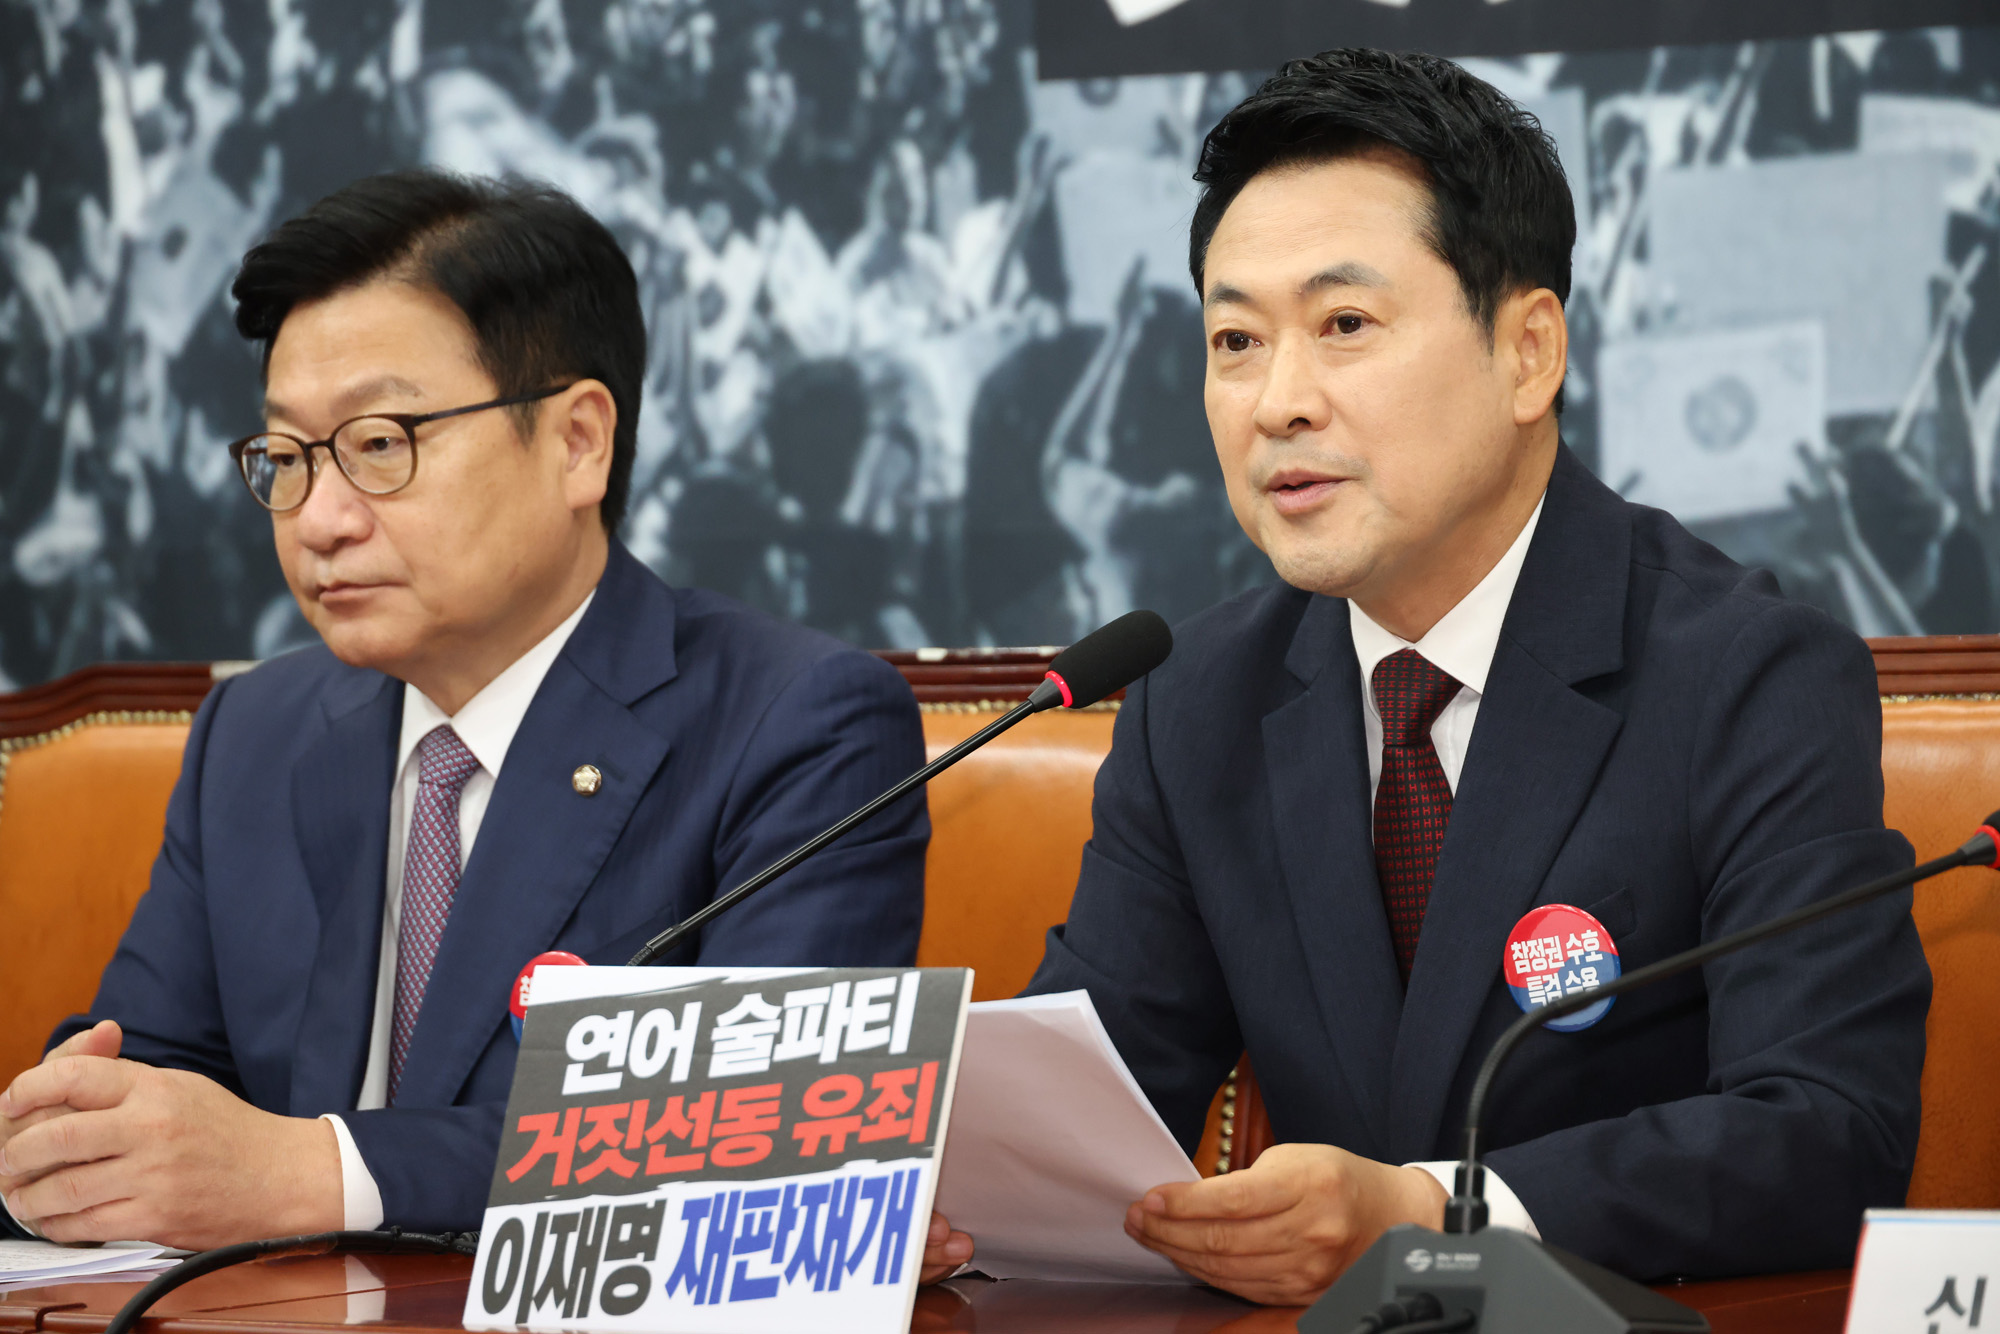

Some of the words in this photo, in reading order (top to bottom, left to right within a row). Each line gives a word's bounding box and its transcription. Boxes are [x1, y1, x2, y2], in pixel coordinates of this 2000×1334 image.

[1510, 935, 1566, 975] 참정권
[1565, 929, 1604, 966] 수호
[561, 1000, 703, 1096] 연어
[707, 970, 922, 1079] 술파티
[505, 1082, 784, 1187] 거짓선동
[791, 1060, 940, 1158] 유죄
[482, 1199, 667, 1325] 이재명
[665, 1167, 921, 1306] 재판재개
